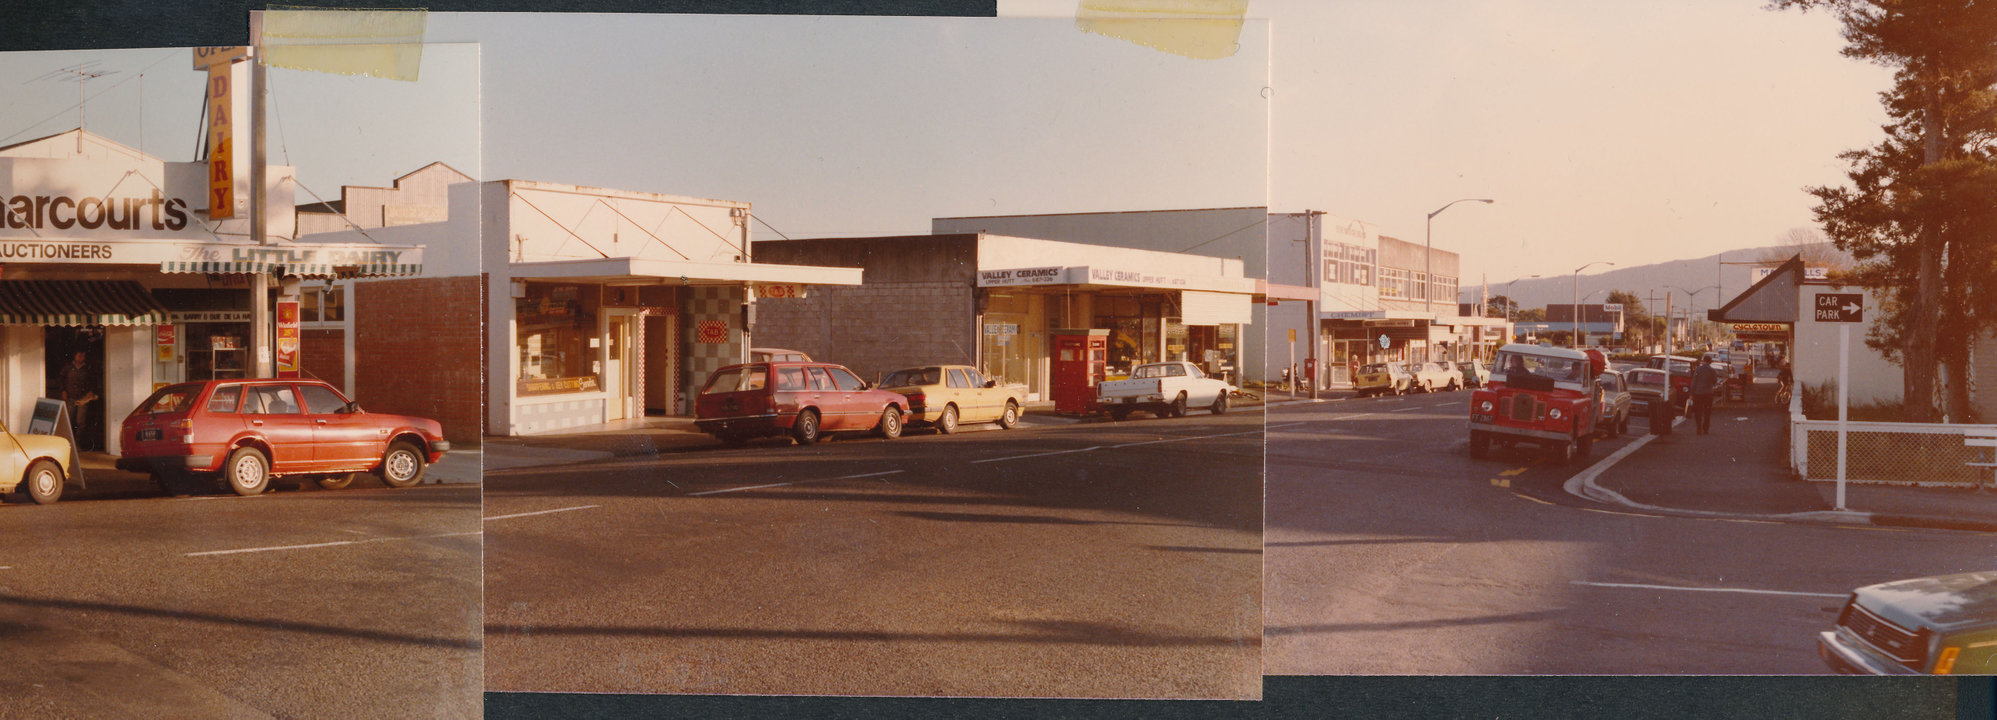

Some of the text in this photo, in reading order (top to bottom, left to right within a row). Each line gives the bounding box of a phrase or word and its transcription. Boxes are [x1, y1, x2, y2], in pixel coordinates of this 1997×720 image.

[213, 75, 228, 209] DAIRY
[0, 244, 112, 259] UCTIONEERS
[180, 247, 402, 264] The LITTLE DAIRY
[982, 268, 1058, 280] VALLEY CERAMICS
[1091, 268, 1113, 280] VALLEY
[1114, 270, 1140, 283] CERAMICS
[1820, 296, 1838, 306] CAR
[1816, 309, 1840, 319] PARK
[706, 328, 719, 336] TAB
